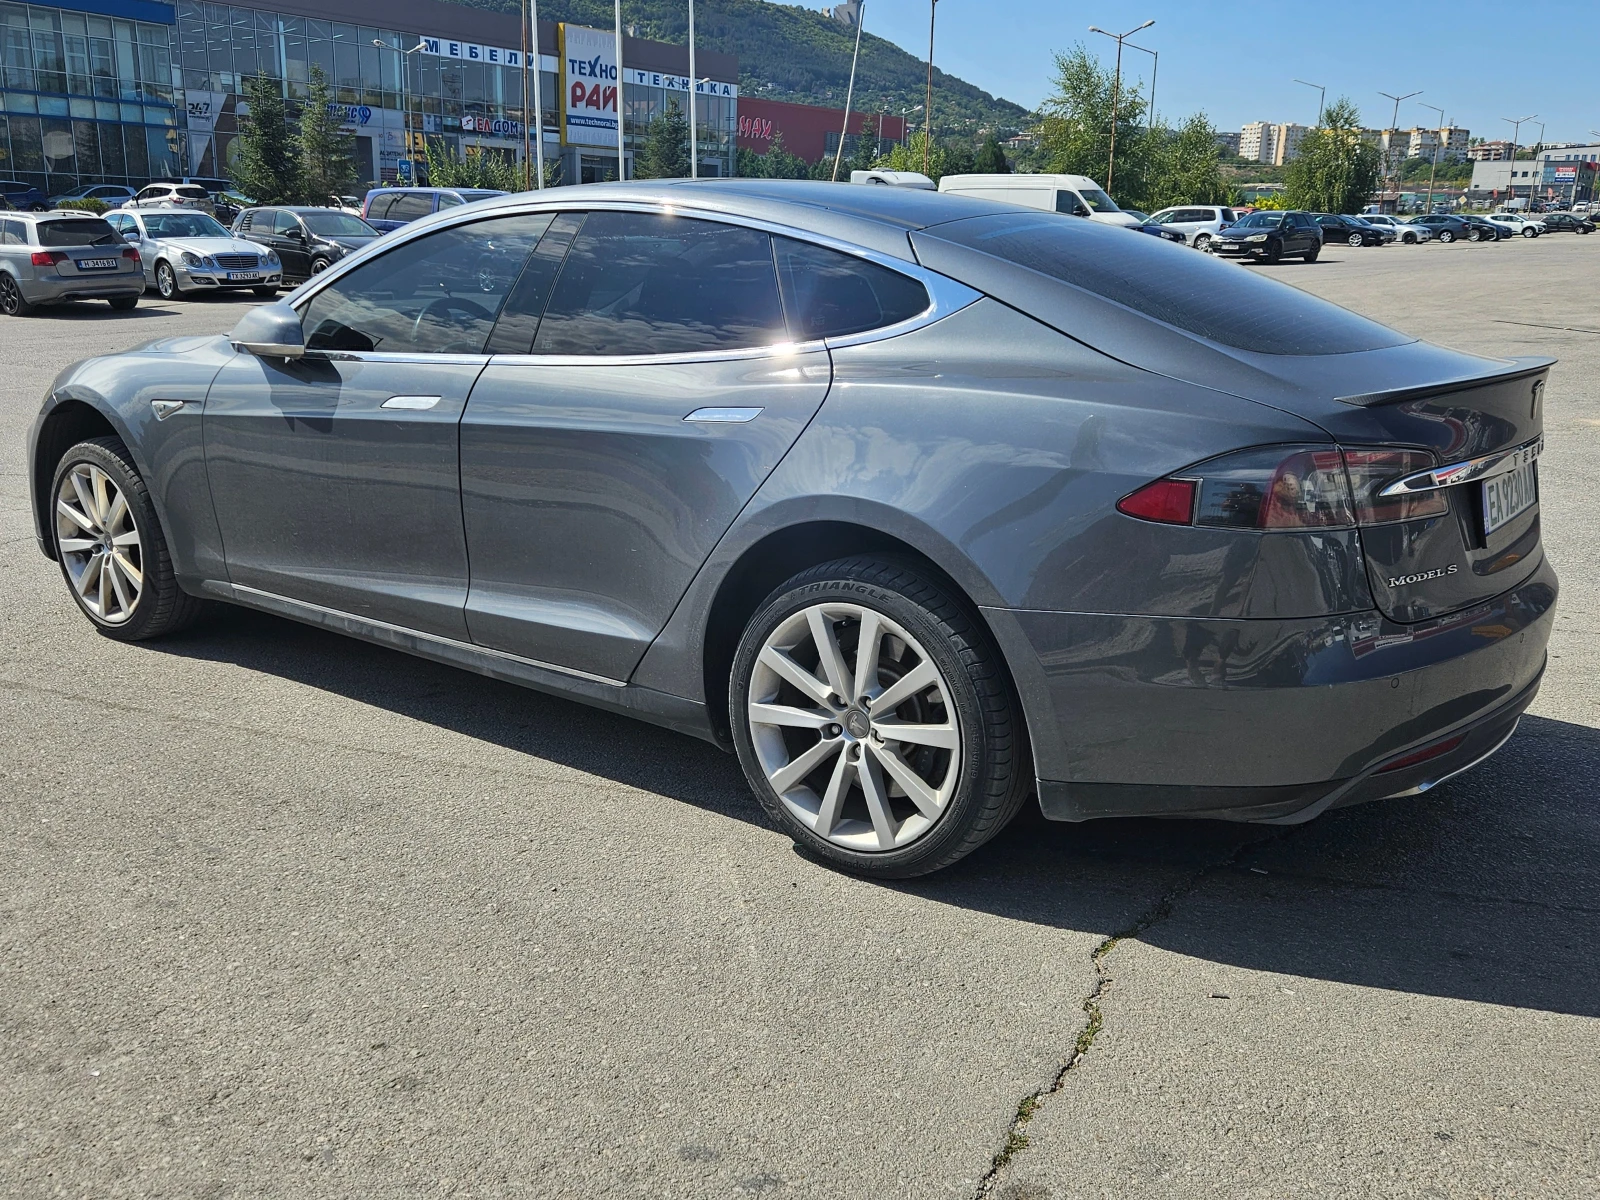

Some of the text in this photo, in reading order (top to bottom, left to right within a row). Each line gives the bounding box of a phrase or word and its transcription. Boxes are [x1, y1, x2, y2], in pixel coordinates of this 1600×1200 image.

[569, 55, 618, 80] ТЕХНО
[637, 72, 731, 96] ТЕХНИКА
[571, 81, 618, 113] РАЙ
[737, 115, 772, 140] MAX
[1388, 564, 1458, 587] MODEL S
[799, 581, 894, 604] TRIANGLE
